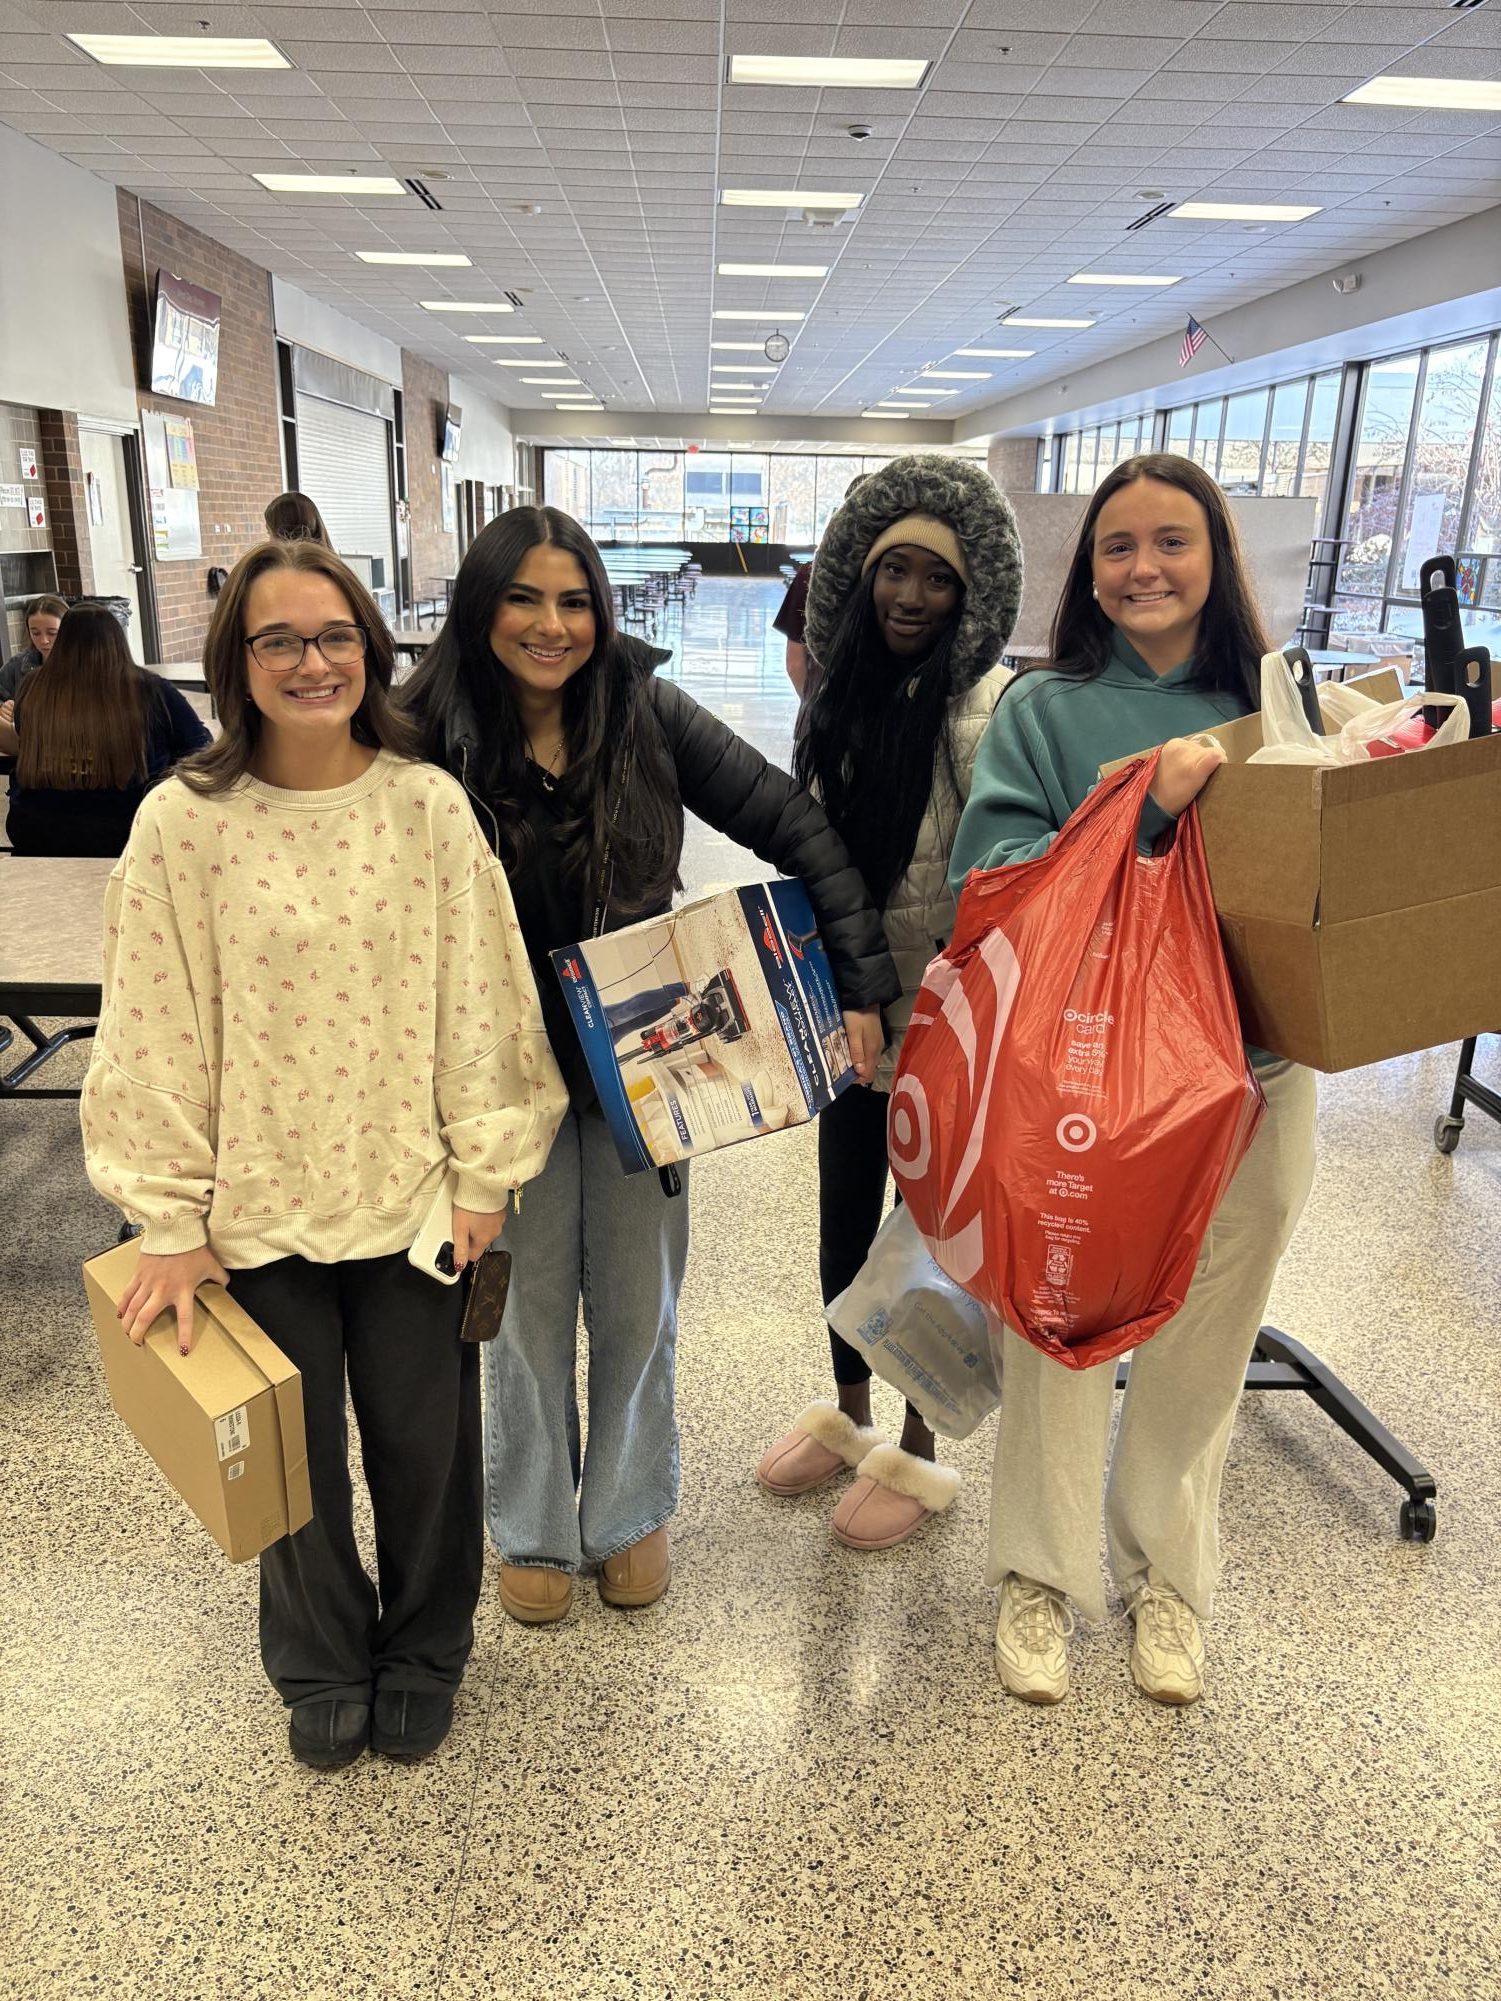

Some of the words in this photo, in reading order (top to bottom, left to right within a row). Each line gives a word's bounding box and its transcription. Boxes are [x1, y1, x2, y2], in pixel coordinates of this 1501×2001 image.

[576, 986, 594, 1028] CLEANVIEW
[1078, 1010, 1114, 1024] circle
[783, 982, 819, 1087] CLEANVIEW
[1076, 1022, 1105, 1034] card
[1067, 1047, 1090, 1057] extra
[1065, 1063, 1087, 1074] every
[671, 1100, 689, 1140] FEATURES
[1056, 1170, 1085, 1182] There's
[1046, 1179, 1067, 1188] more
[1067, 1181, 1094, 1192] Target
[1049, 1187, 1058, 1195] at
[1067, 1191, 1088, 1200] .com
[1040, 1212, 1054, 1220] This
[1055, 1215, 1067, 1223] bag
[1075, 1218, 1089, 1226] 40%
[1038, 1220, 1065, 1229] recycled
[1065, 1224, 1092, 1233] content.
